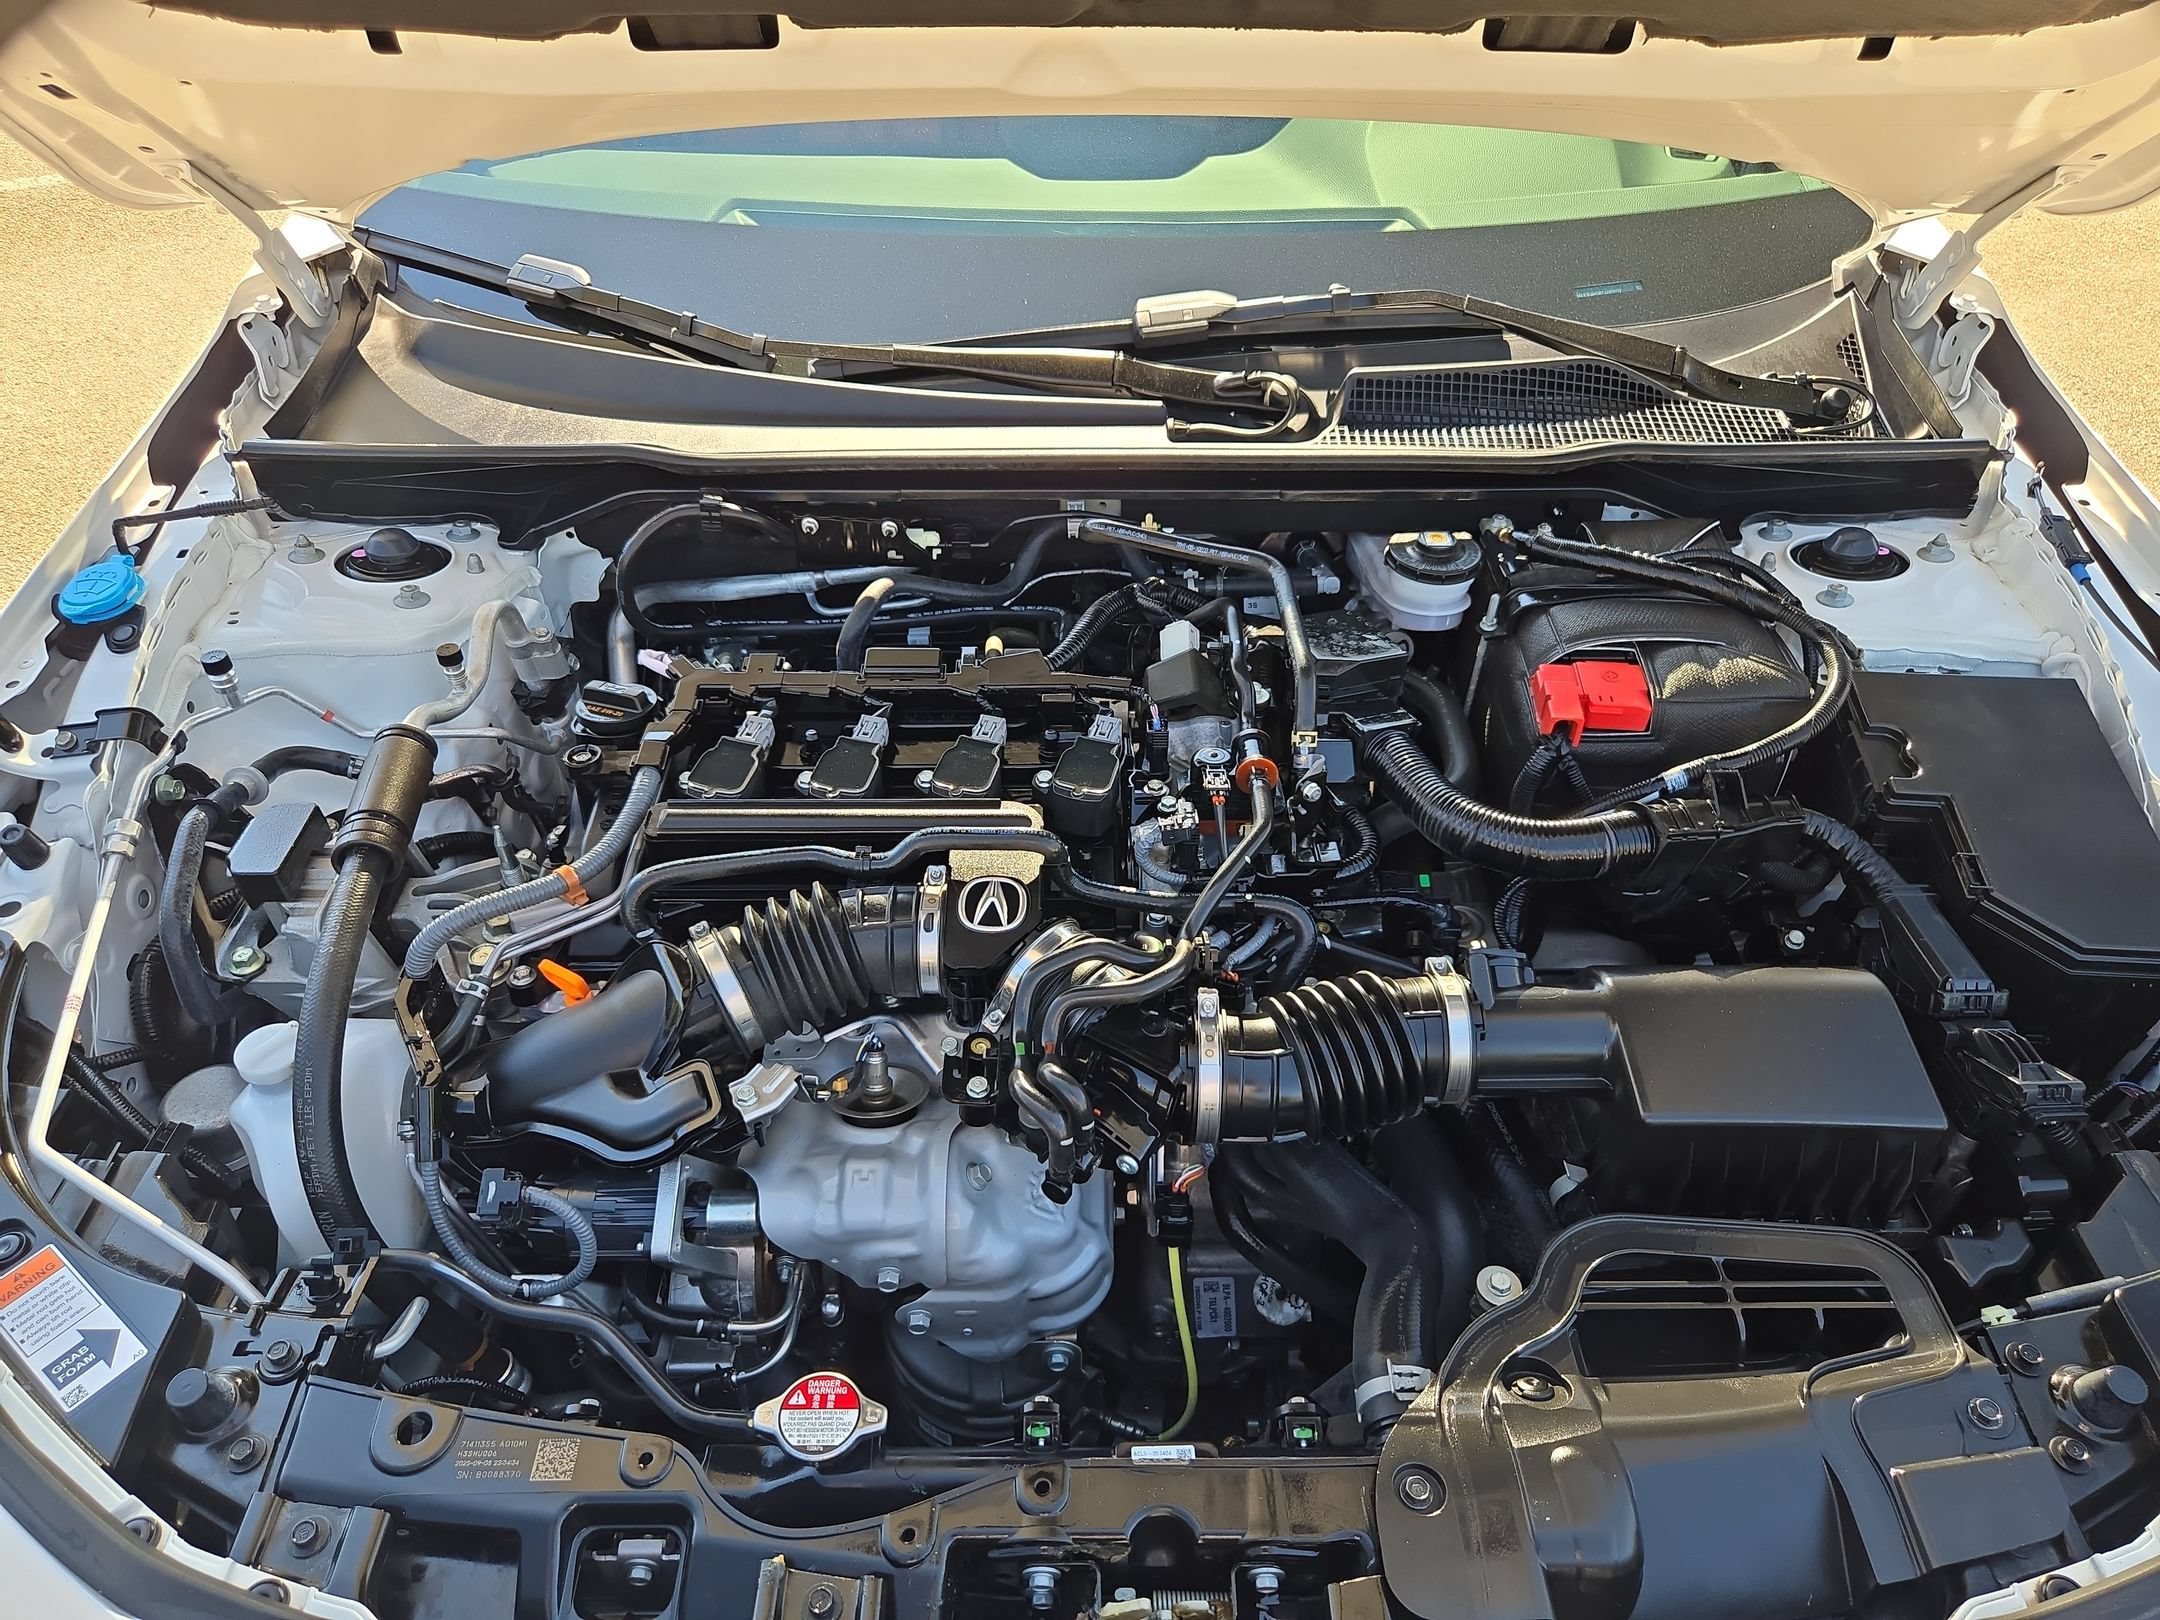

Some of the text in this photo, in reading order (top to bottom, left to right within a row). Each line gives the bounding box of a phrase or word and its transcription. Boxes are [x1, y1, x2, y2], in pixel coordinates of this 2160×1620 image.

[6, 1275, 66, 1317] Do not touch bare
[11, 1309, 32, 1323] metal
[32, 1301, 40, 1309] or
[40, 1289, 58, 1304] white
[16, 1286, 77, 1330] Metal rod gets hot
[21, 1288, 86, 1335] and can burn hand.
[26, 1306, 73, 1342] Always lift rod
[30, 1306, 87, 1347] using foam area.
[51, 1345, 90, 1375] GRAB
[57, 1352, 97, 1384] FOAM
[808, 1379, 841, 1387] DANGER
[808, 1387, 848, 1395] WARNUNG
[455, 1470, 474, 1480] SN:
